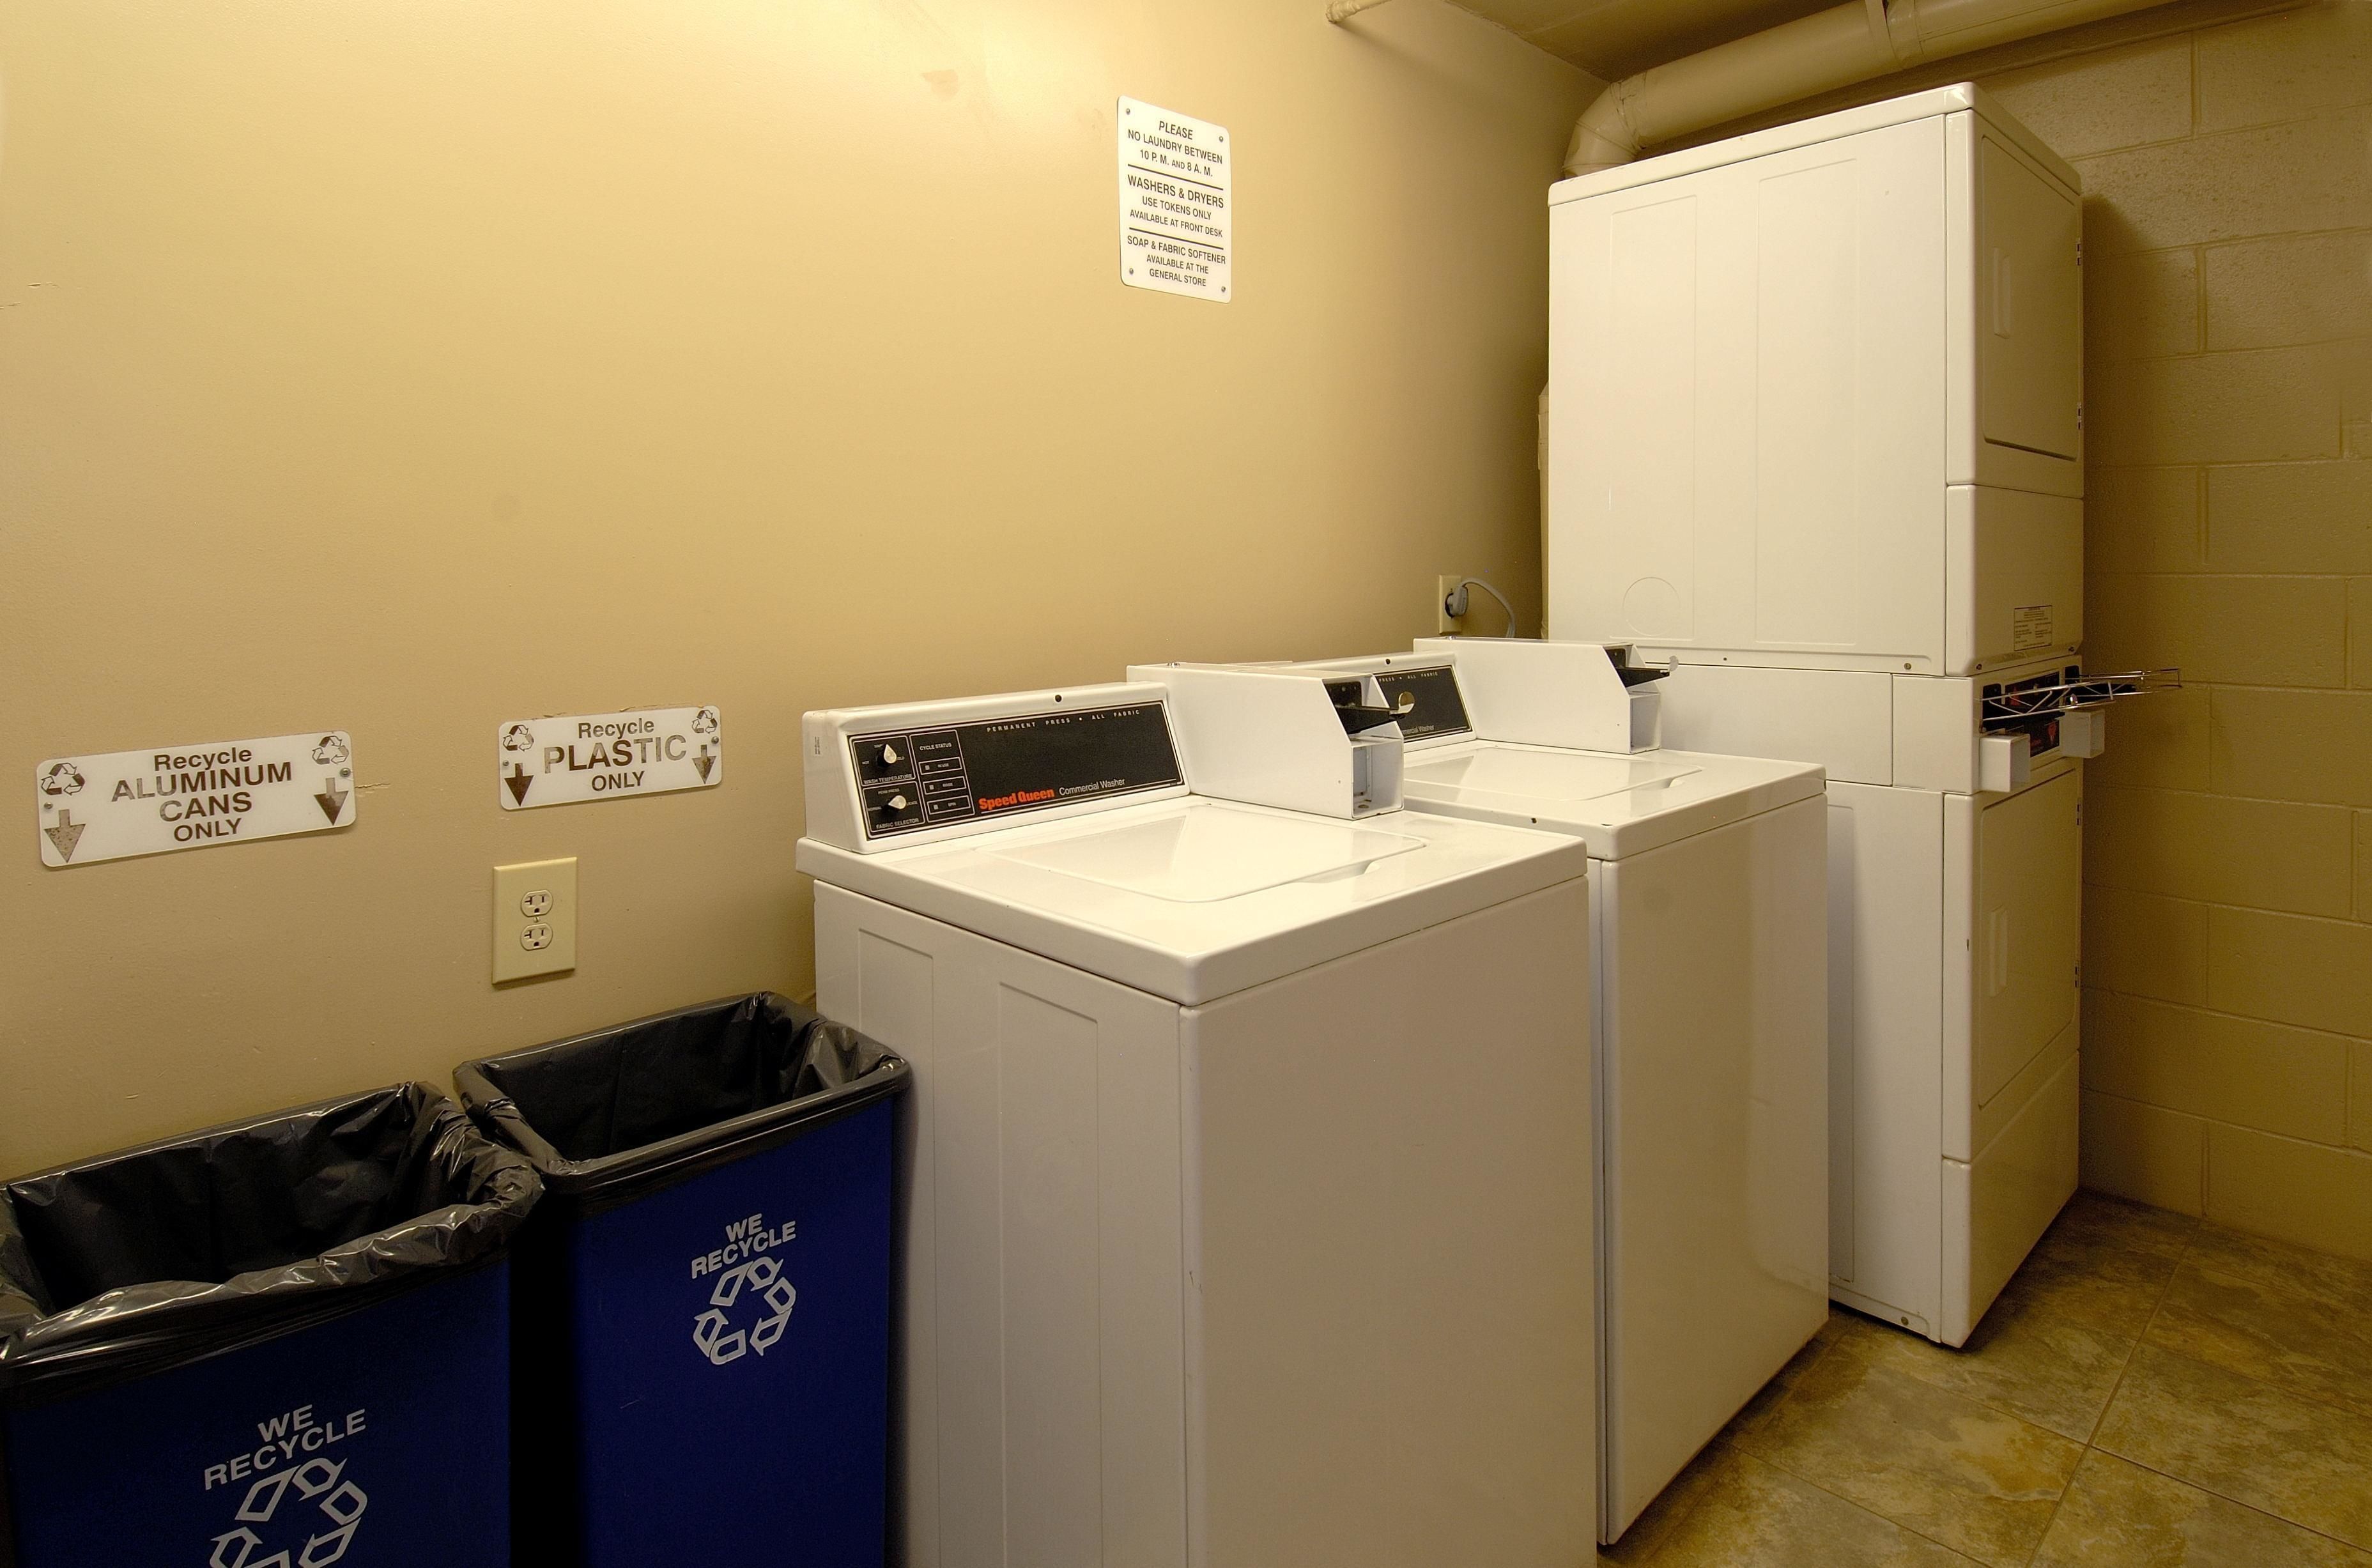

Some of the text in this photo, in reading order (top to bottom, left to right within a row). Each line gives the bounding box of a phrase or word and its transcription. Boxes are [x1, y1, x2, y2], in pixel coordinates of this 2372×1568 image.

[1159, 121, 1193, 140] PLEASE
[1128, 129, 1222, 164] NO LAUNDRY BETWEEN
[1140, 149, 1149, 160] 10
[1171, 160, 1185, 169] AND
[1187, 162, 1192, 171] 8
[1128, 174, 1224, 208] WASHERS & DRYERS
[1143, 196, 1212, 220] USE TOKENS ONLY
[1130, 210, 1223, 238] AVAILABLE AT FRONT DESK
[1127, 235, 1226, 265] SOAP & FABRIC SOFTENER
[1146, 254, 1209, 274] AVAILABLE AT THE
[1150, 268, 1206, 286] GENERAL STORE
[578, 717, 655, 740] Recycle
[987, 721, 1036, 733] PERMANENT
[1045, 717, 1071, 726] PRESS
[1114, 709, 1140, 718] FABRIC
[153, 747, 252, 771] Recycle
[544, 734, 687, 774] PLASTIC
[111, 762, 292, 803] ALUMINUM
[592, 771, 645, 792] ONLY
[879, 774, 913, 782] TEMPERATURE
[1059, 778, 1125, 796] Commercial Washer
[159, 792, 253, 822] CANS
[978, 788, 1055, 811] Speed Queen
[174, 818, 242, 842] ONLY
[895, 818, 919, 827] SELECTOR
[725, 1213, 763, 1242] WE
[691, 1220, 796, 1279] RECYCLE
[258, 1404, 314, 1443] WE
[204, 1408, 366, 1491] RECYCLE
